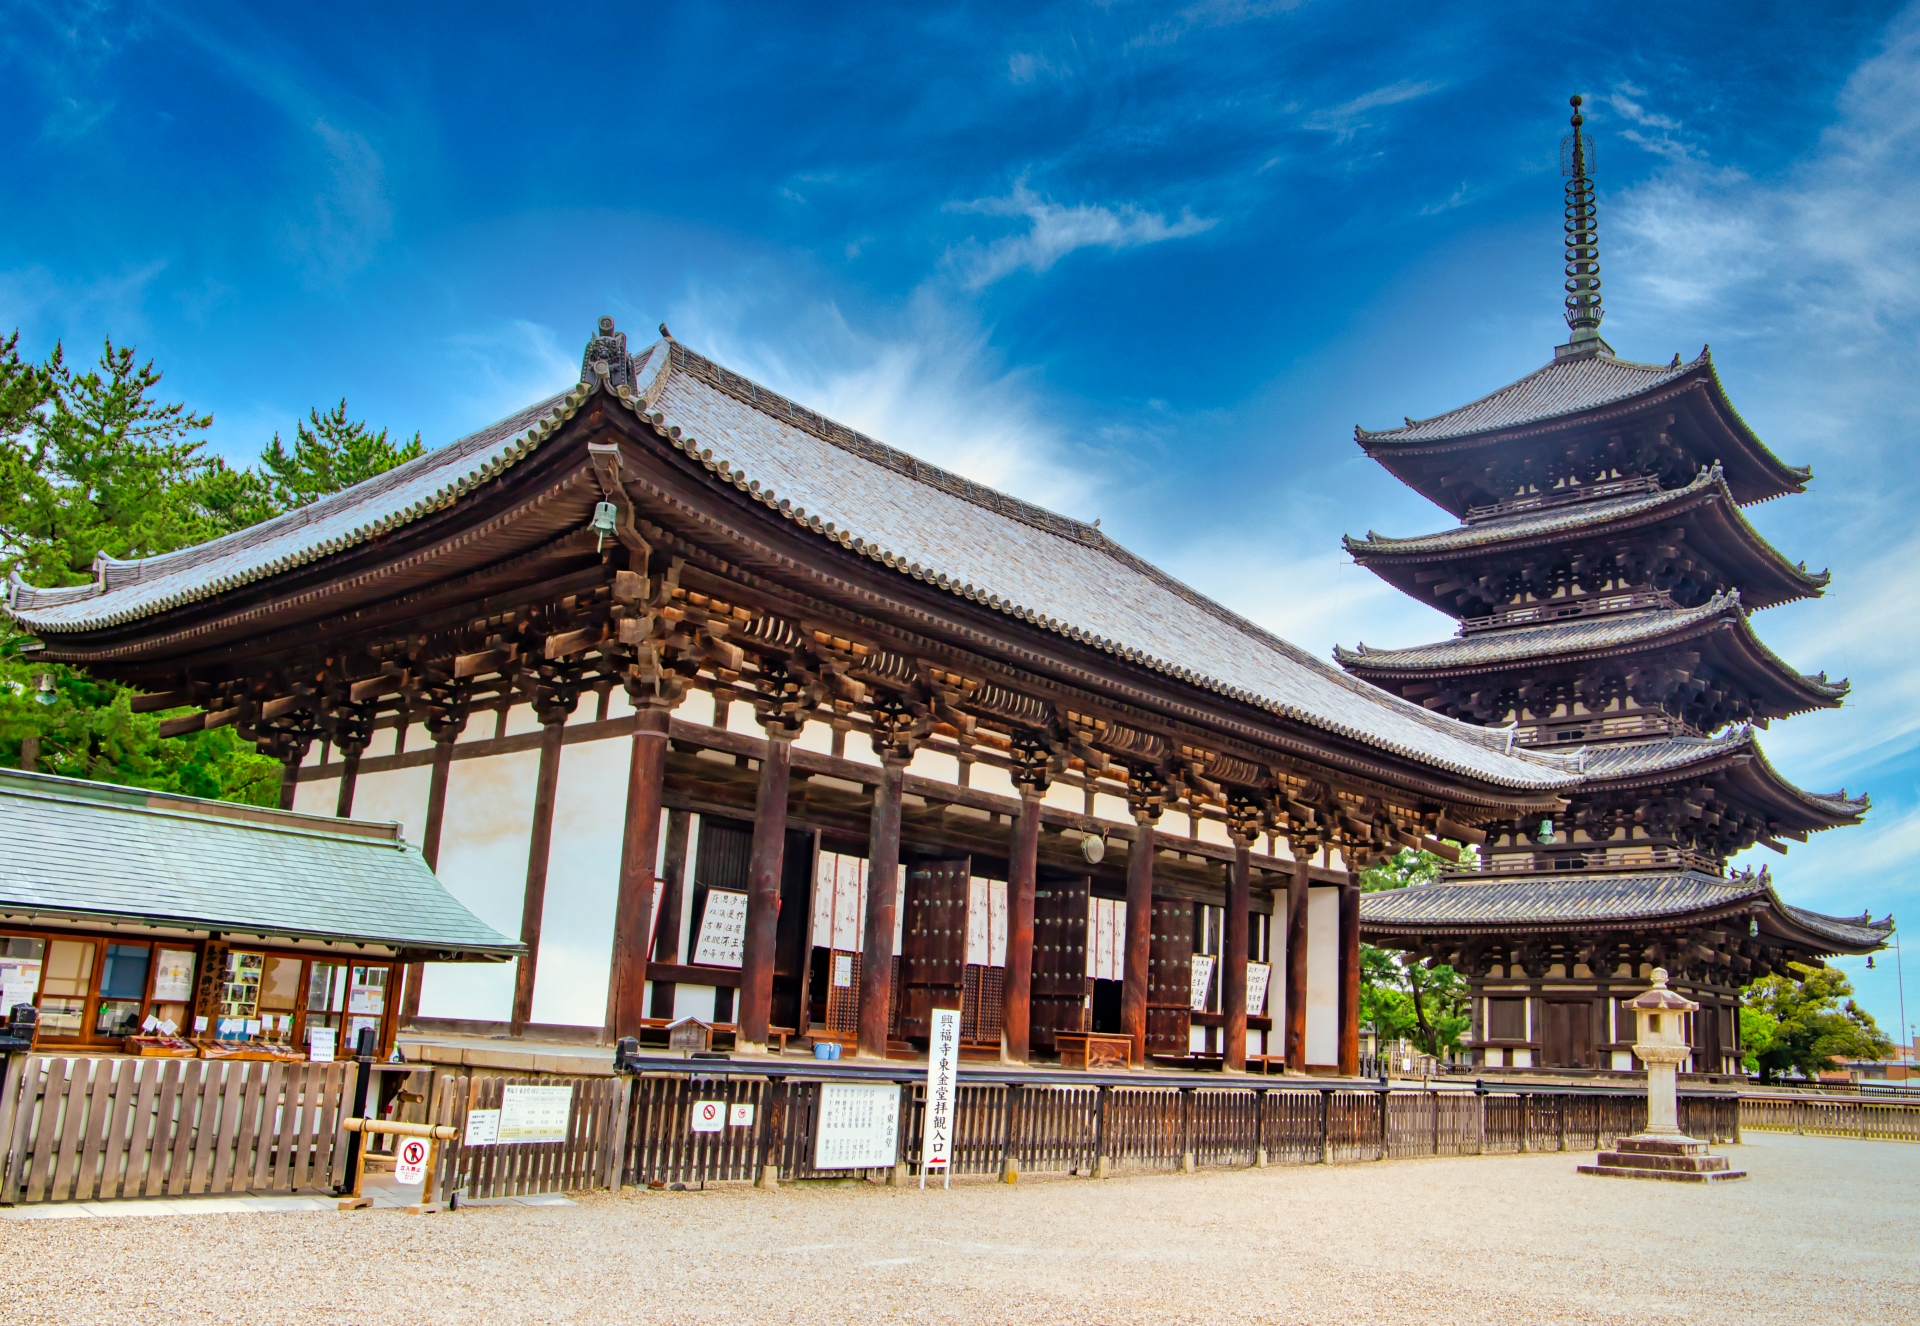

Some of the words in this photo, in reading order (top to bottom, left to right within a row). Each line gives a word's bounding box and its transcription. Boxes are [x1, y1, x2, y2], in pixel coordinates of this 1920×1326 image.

[931, 1014, 954, 1153] 興福寺東金堂拝観入口
[885, 1113, 894, 1148] 東金堂
[400, 1165, 421, 1173] 立入禁止
